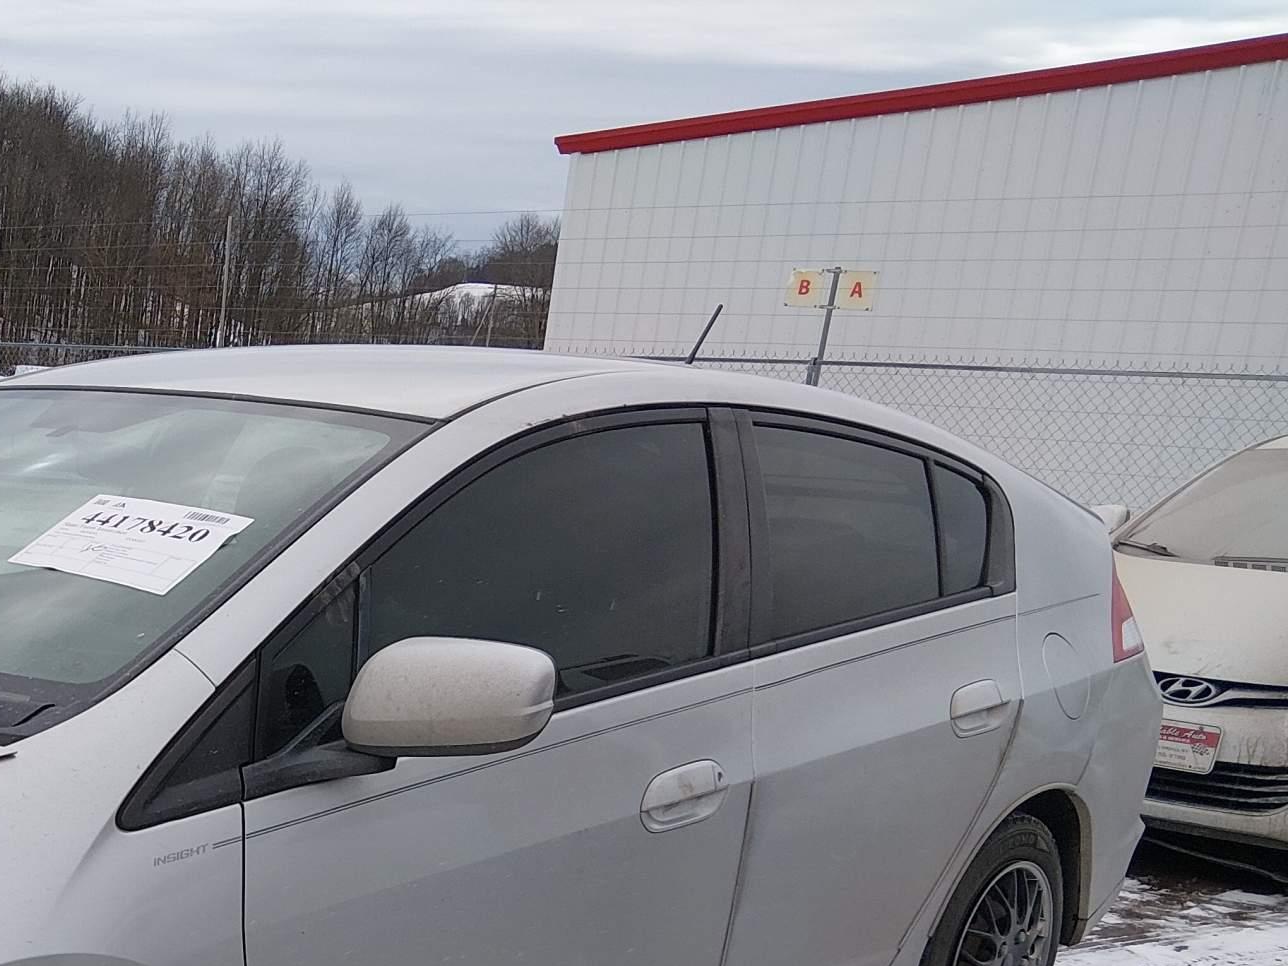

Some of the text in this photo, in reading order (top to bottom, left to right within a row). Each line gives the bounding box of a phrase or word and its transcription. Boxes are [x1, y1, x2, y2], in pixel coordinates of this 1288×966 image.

[798, 279, 811, 295] B
[850, 282, 863, 298] A
[81, 511, 210, 543] 44178420
[153, 843, 209, 867] INSIGHT
